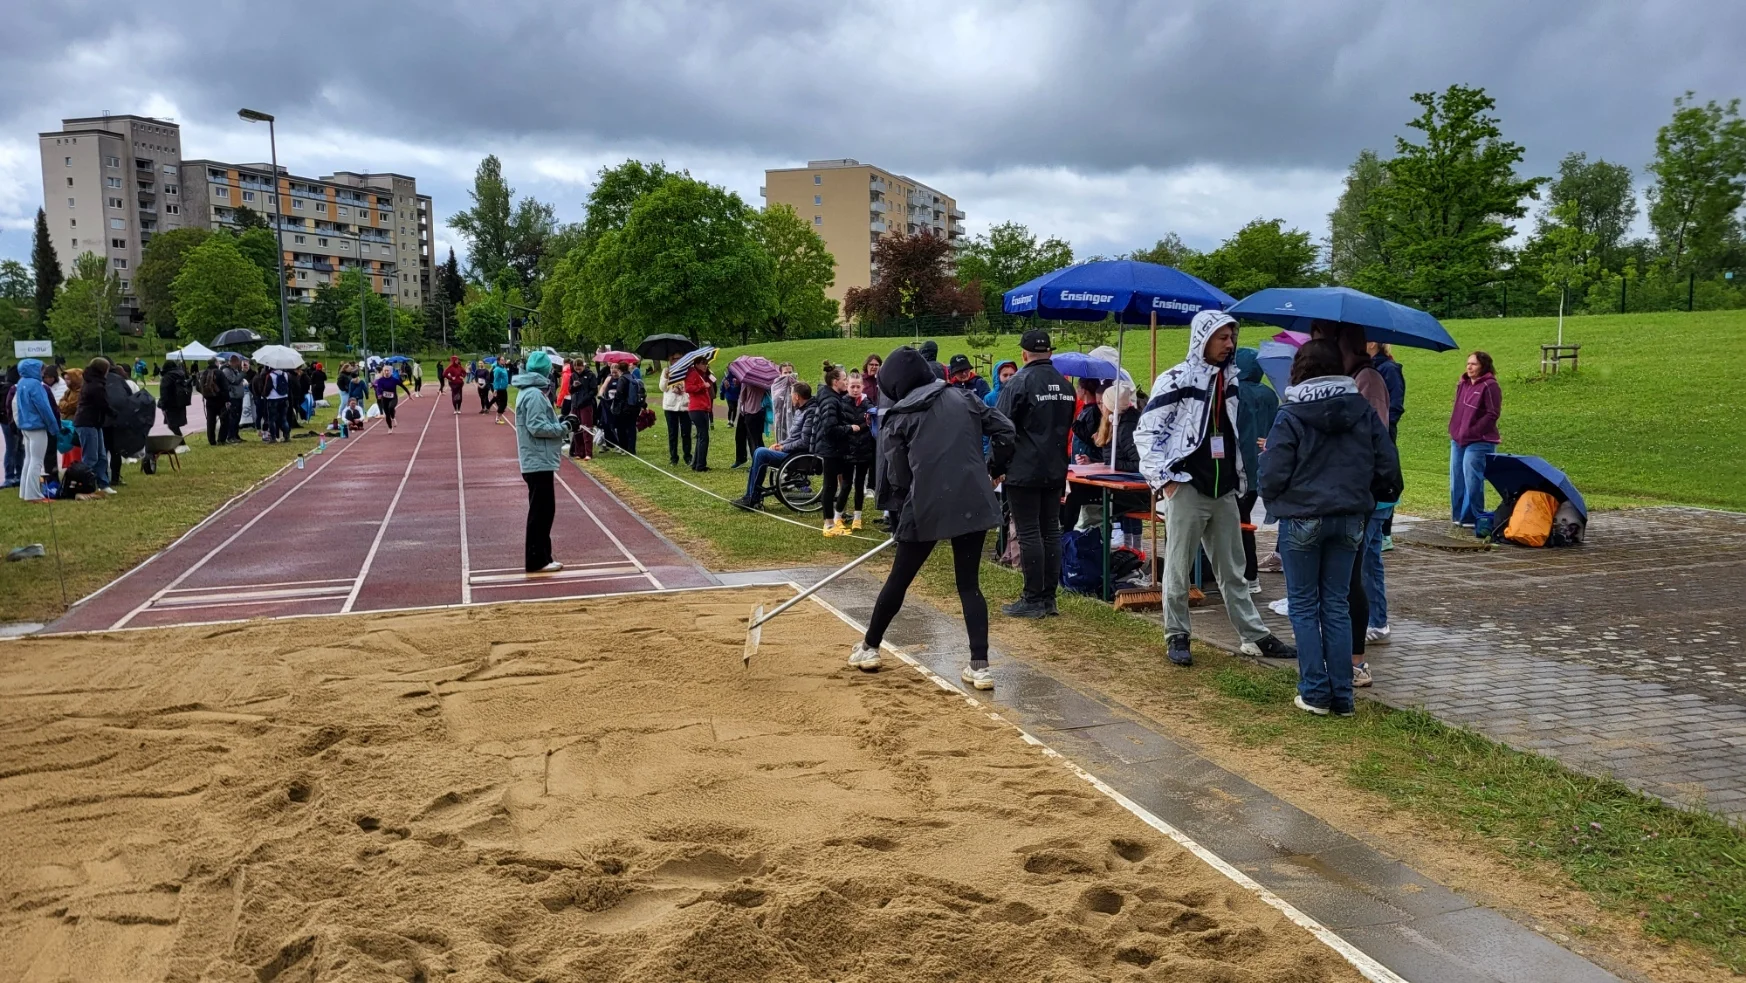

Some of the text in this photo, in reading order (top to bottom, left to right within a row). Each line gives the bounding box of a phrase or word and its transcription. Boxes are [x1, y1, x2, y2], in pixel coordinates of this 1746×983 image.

[1060, 290, 1114, 305] Ensinger
[1152, 296, 1202, 314] Ensinger
[1047, 384, 1060, 392] DTB
